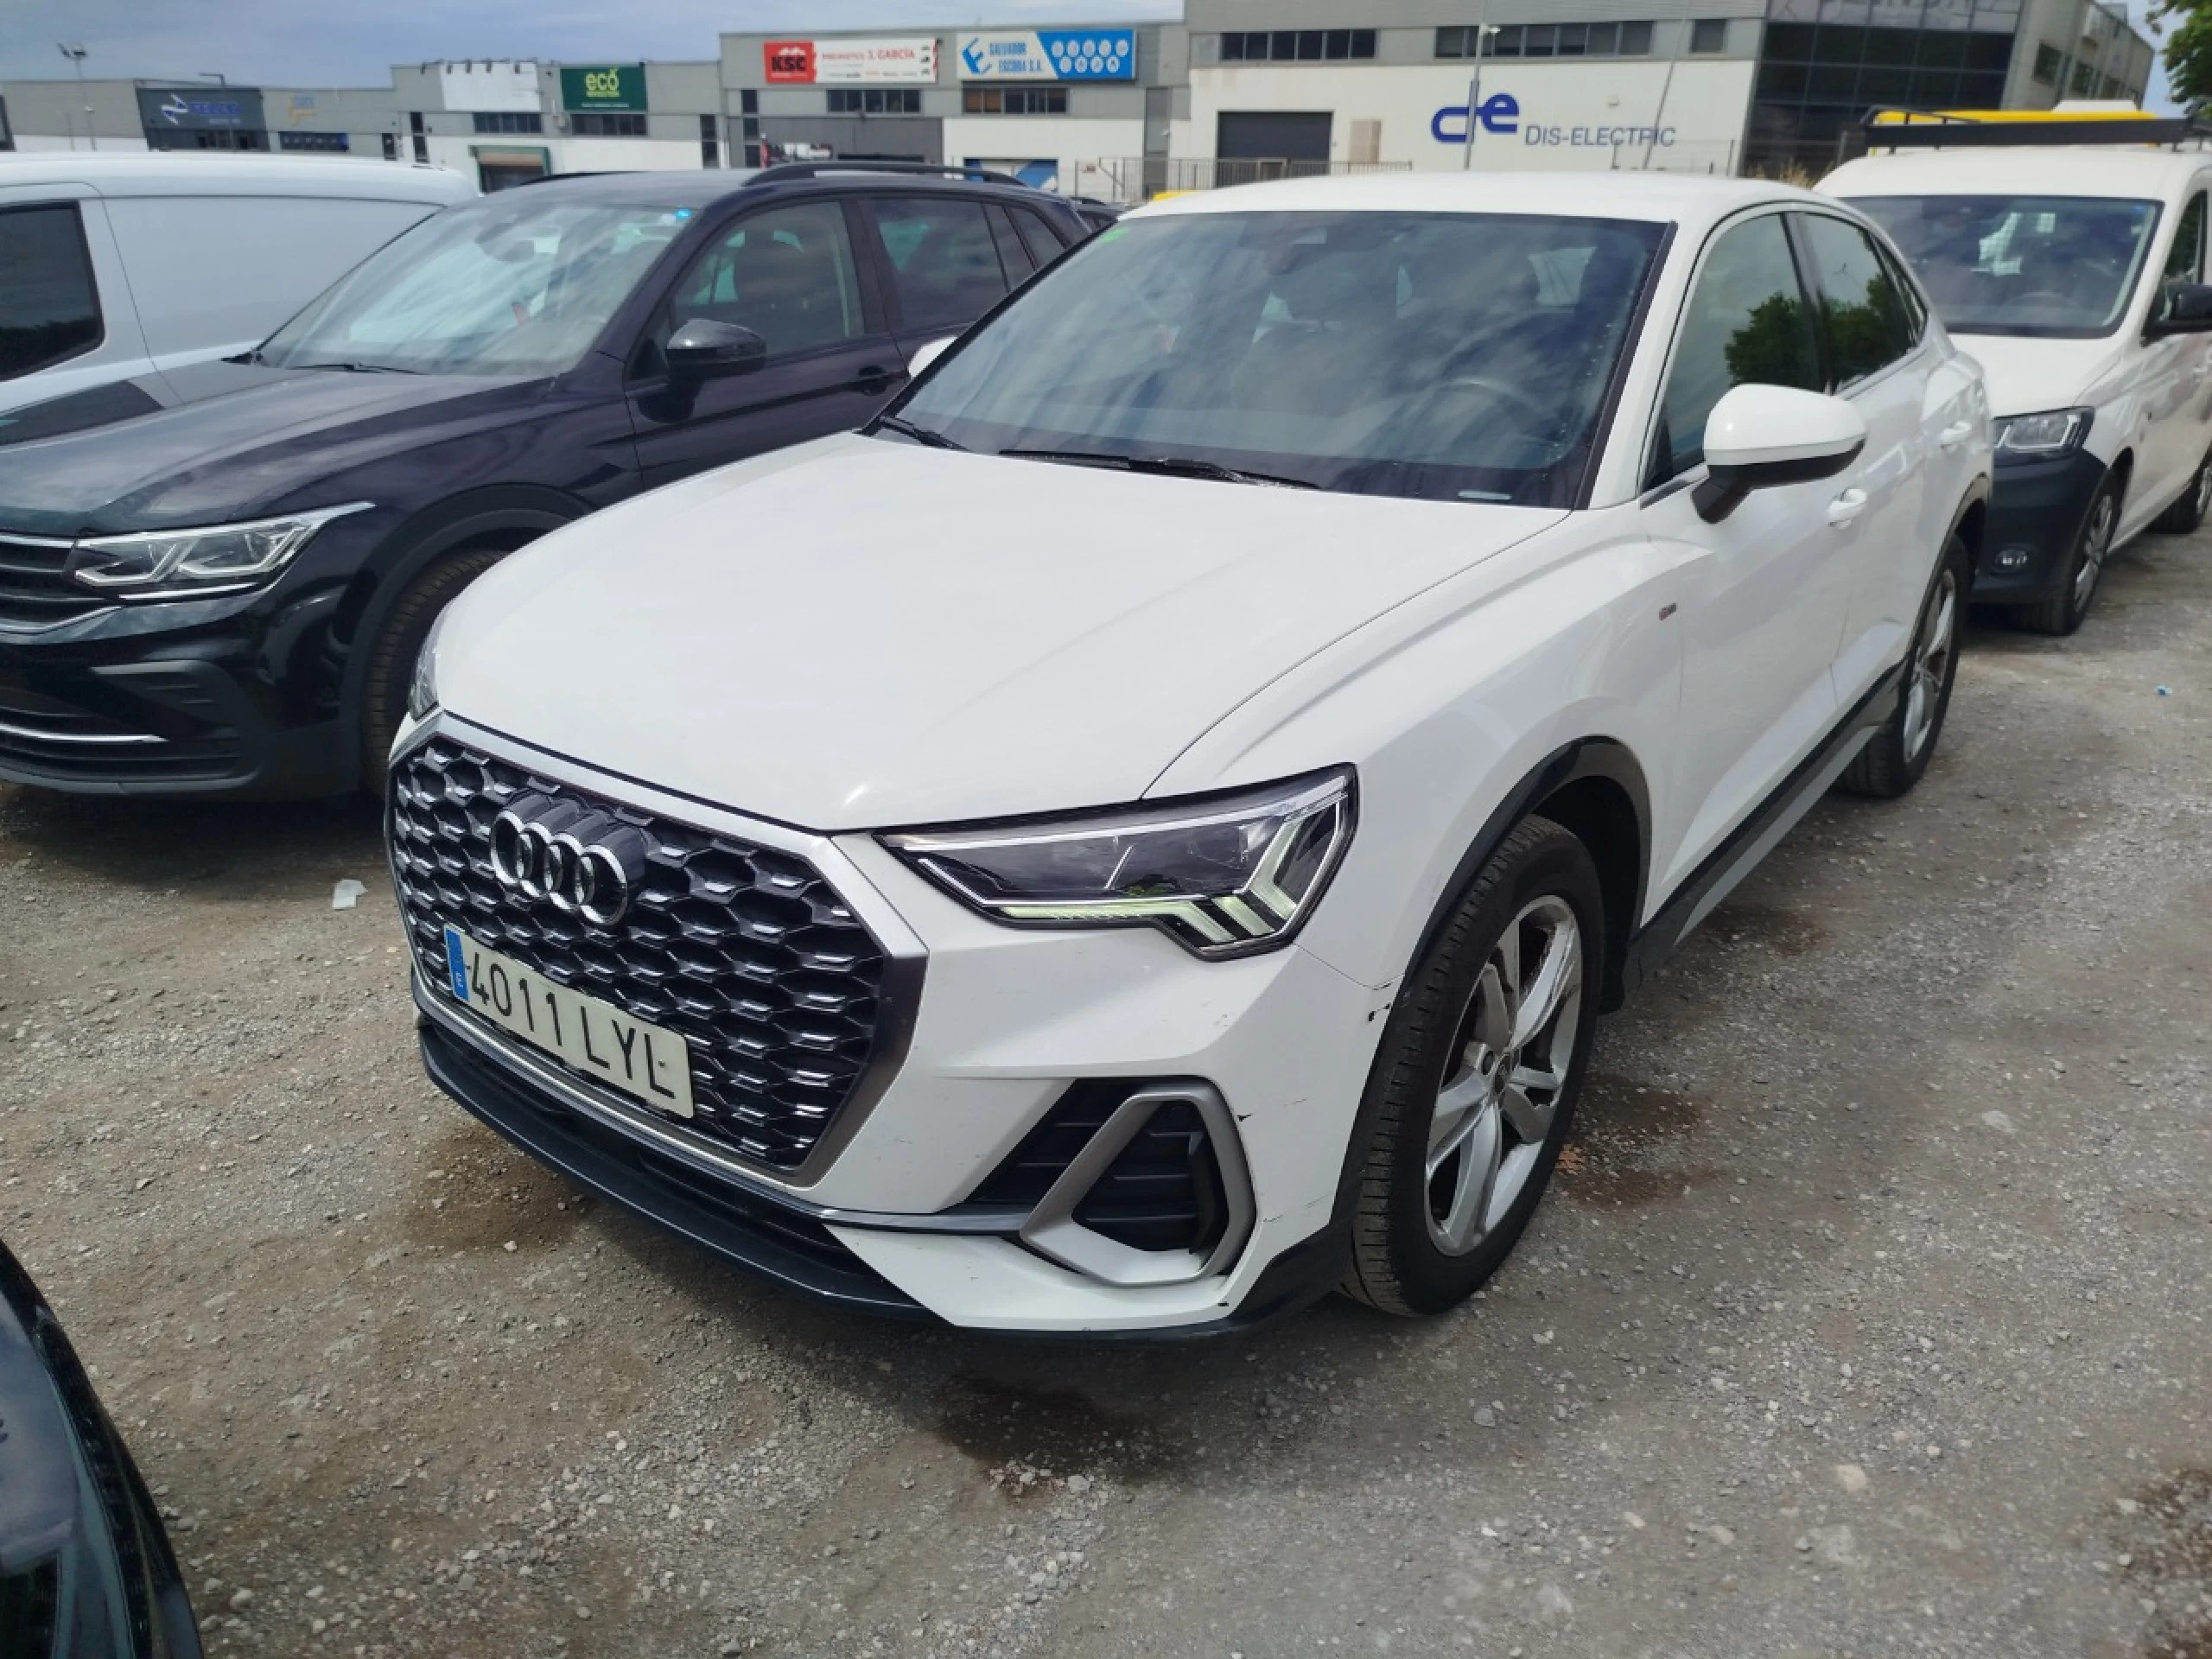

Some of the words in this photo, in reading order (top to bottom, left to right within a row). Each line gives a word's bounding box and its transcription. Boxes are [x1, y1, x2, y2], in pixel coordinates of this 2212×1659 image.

[772, 56, 806, 72] KSC
[1525, 124, 1676, 146] DIS-ELECTRIC
[471, 951, 562, 1047] 4011
[580, 1005, 677, 1099] LYL
